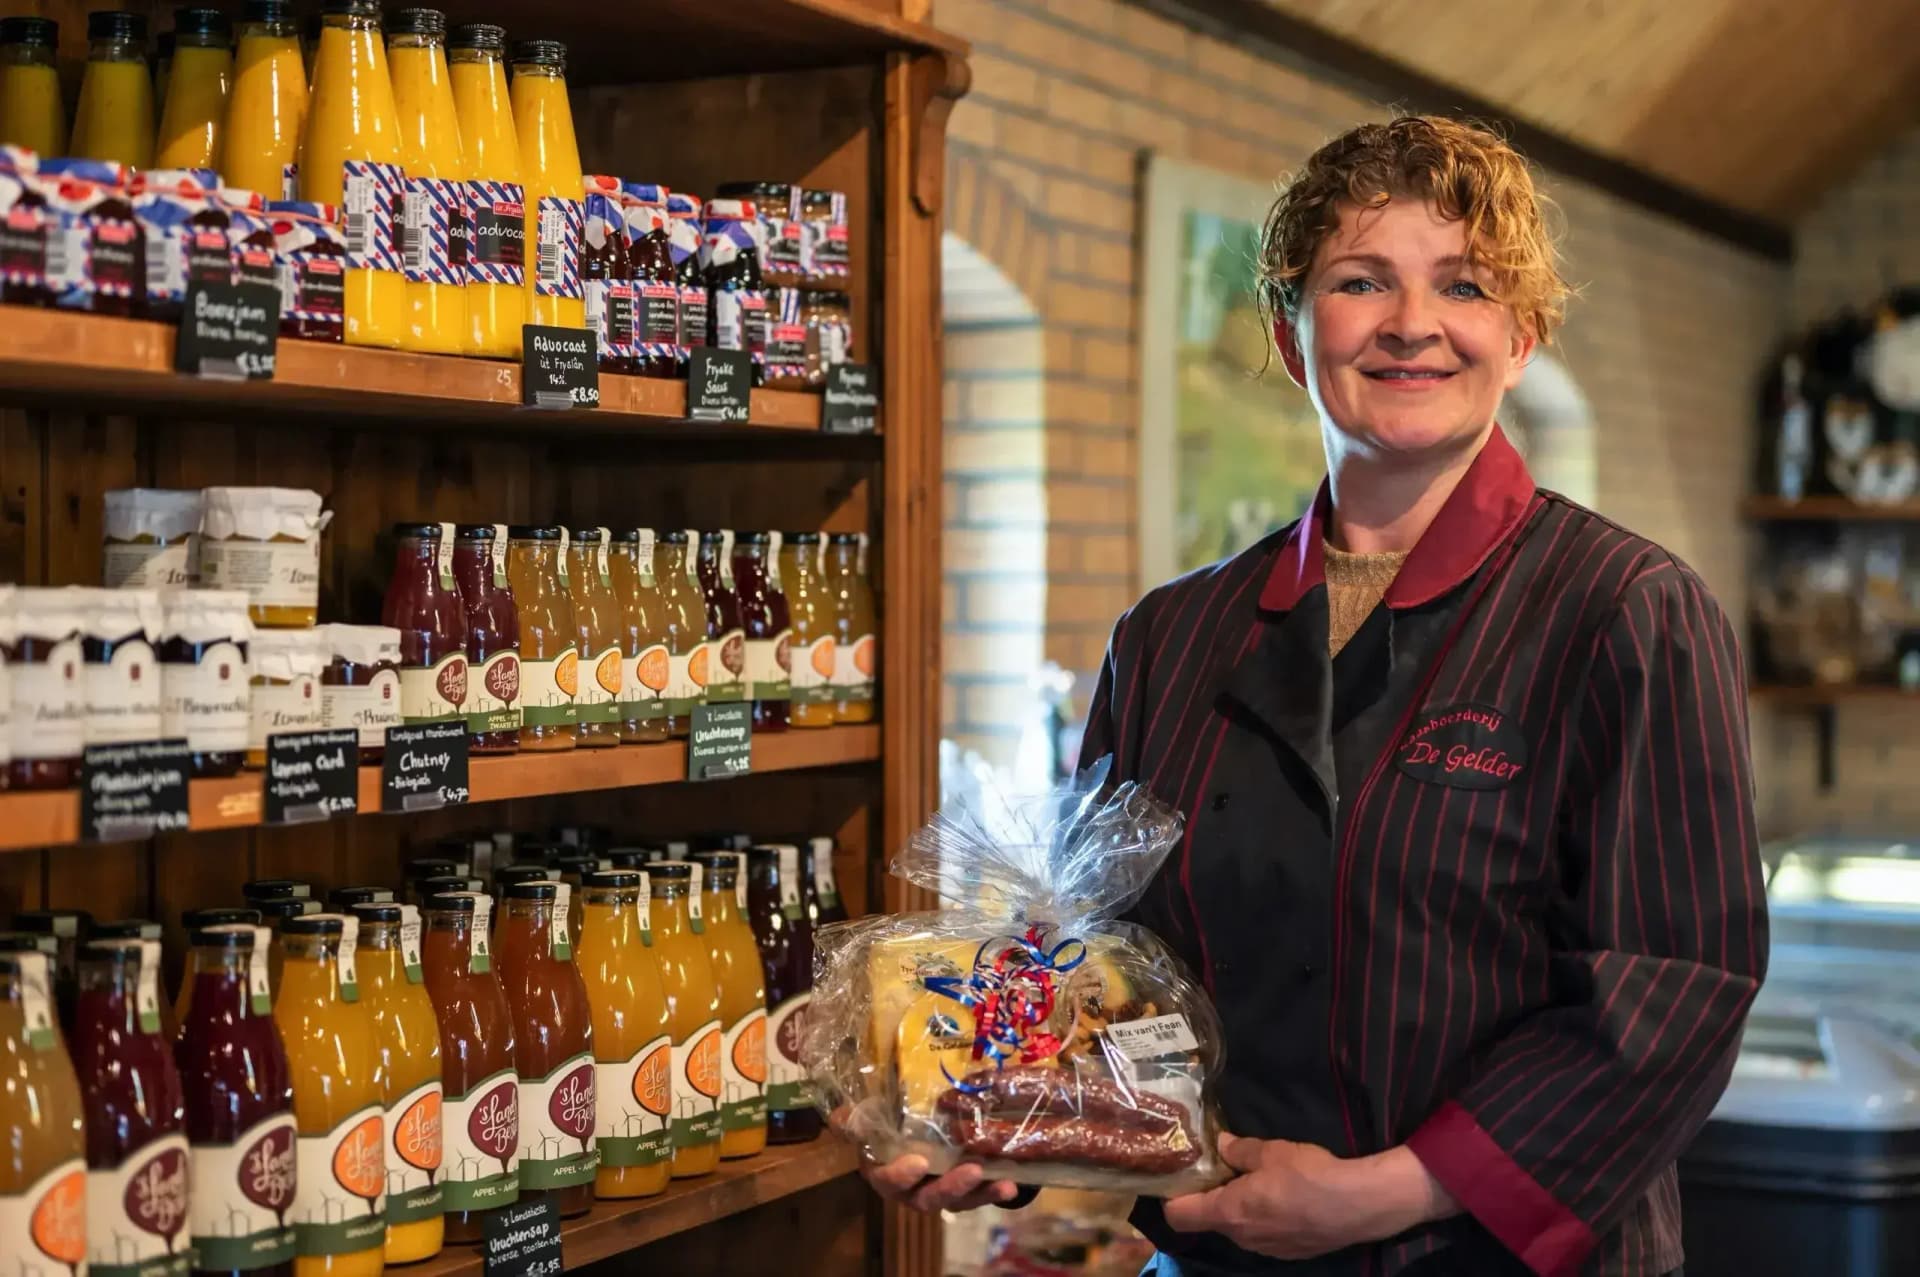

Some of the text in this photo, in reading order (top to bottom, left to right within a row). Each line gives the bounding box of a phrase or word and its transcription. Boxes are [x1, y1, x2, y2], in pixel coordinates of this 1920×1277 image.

[534, 336, 587, 353] Advocaat
[569, 387, 599, 403] €8,50
[400, 750, 451, 772] Chutney
[1406, 742, 1523, 780] De Gelder
[1115, 1020, 1182, 1038] Mix van't Fean
[553, 1165, 577, 1177] APPEL
[472, 1186, 496, 1198] APPEL
